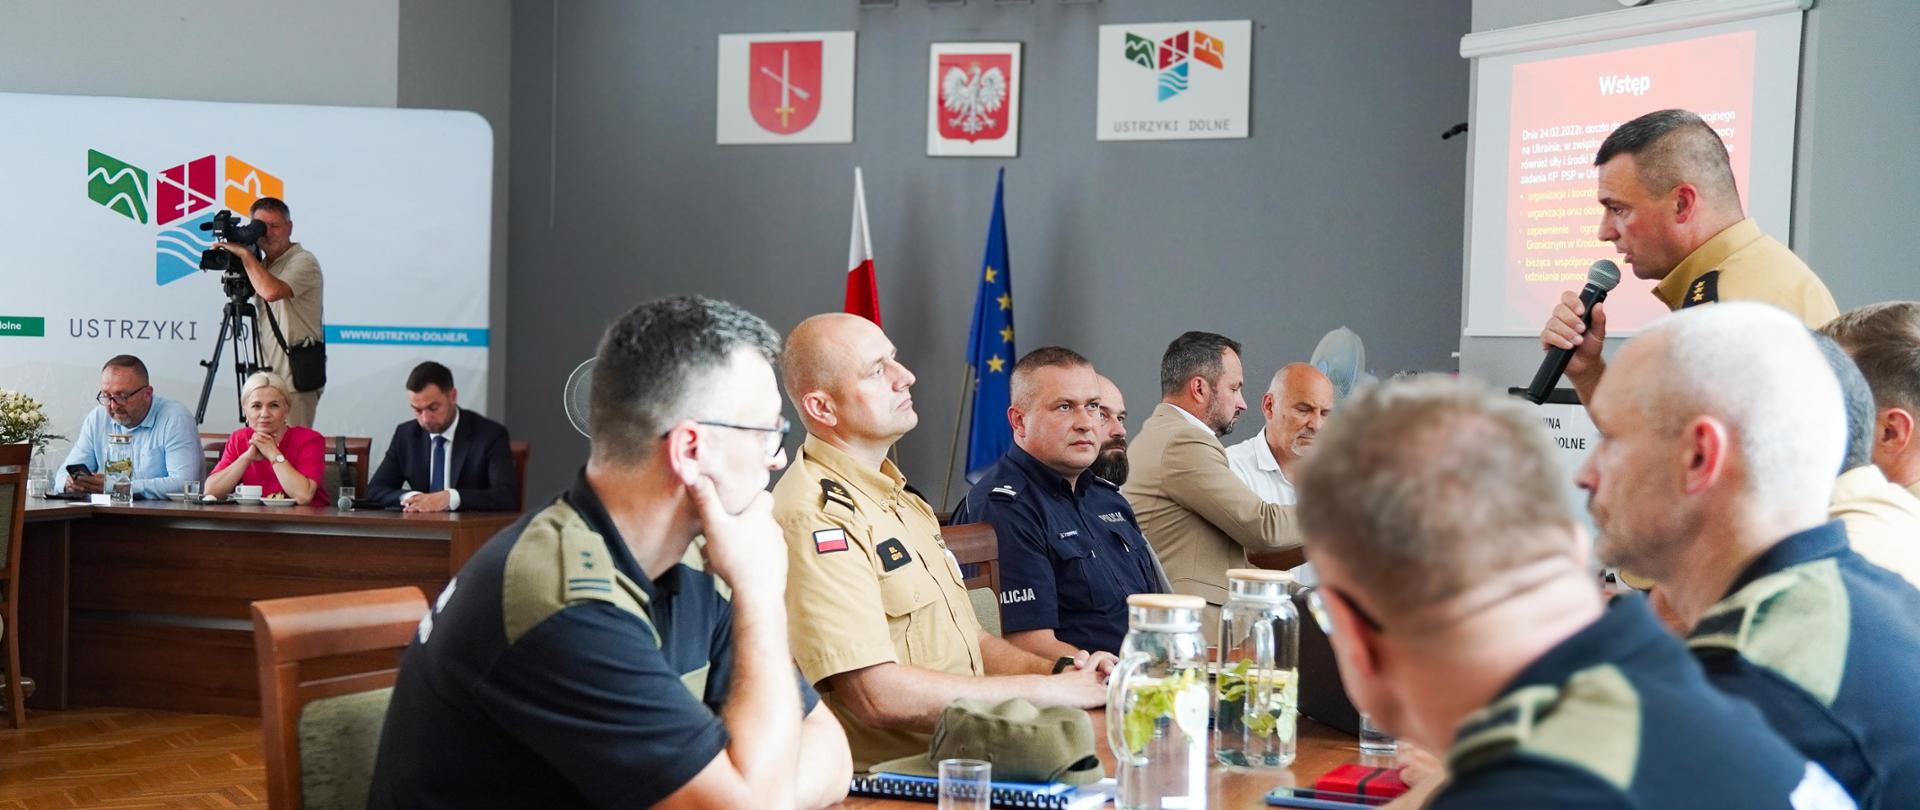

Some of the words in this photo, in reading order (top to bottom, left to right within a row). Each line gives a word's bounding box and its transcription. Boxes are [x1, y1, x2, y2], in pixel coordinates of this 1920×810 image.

[1599, 74, 1650, 96] Wstęp
[1113, 120, 1178, 133] USTRZYKI
[1188, 118, 1231, 131] DOLNE
[1561, 169, 1576, 181] PSP
[69, 318, 198, 341] USTRZYKI
[340, 330, 468, 342] WWW.USTRZYKI-DOLNE.PL
[1098, 511, 1126, 523] POLICJA
